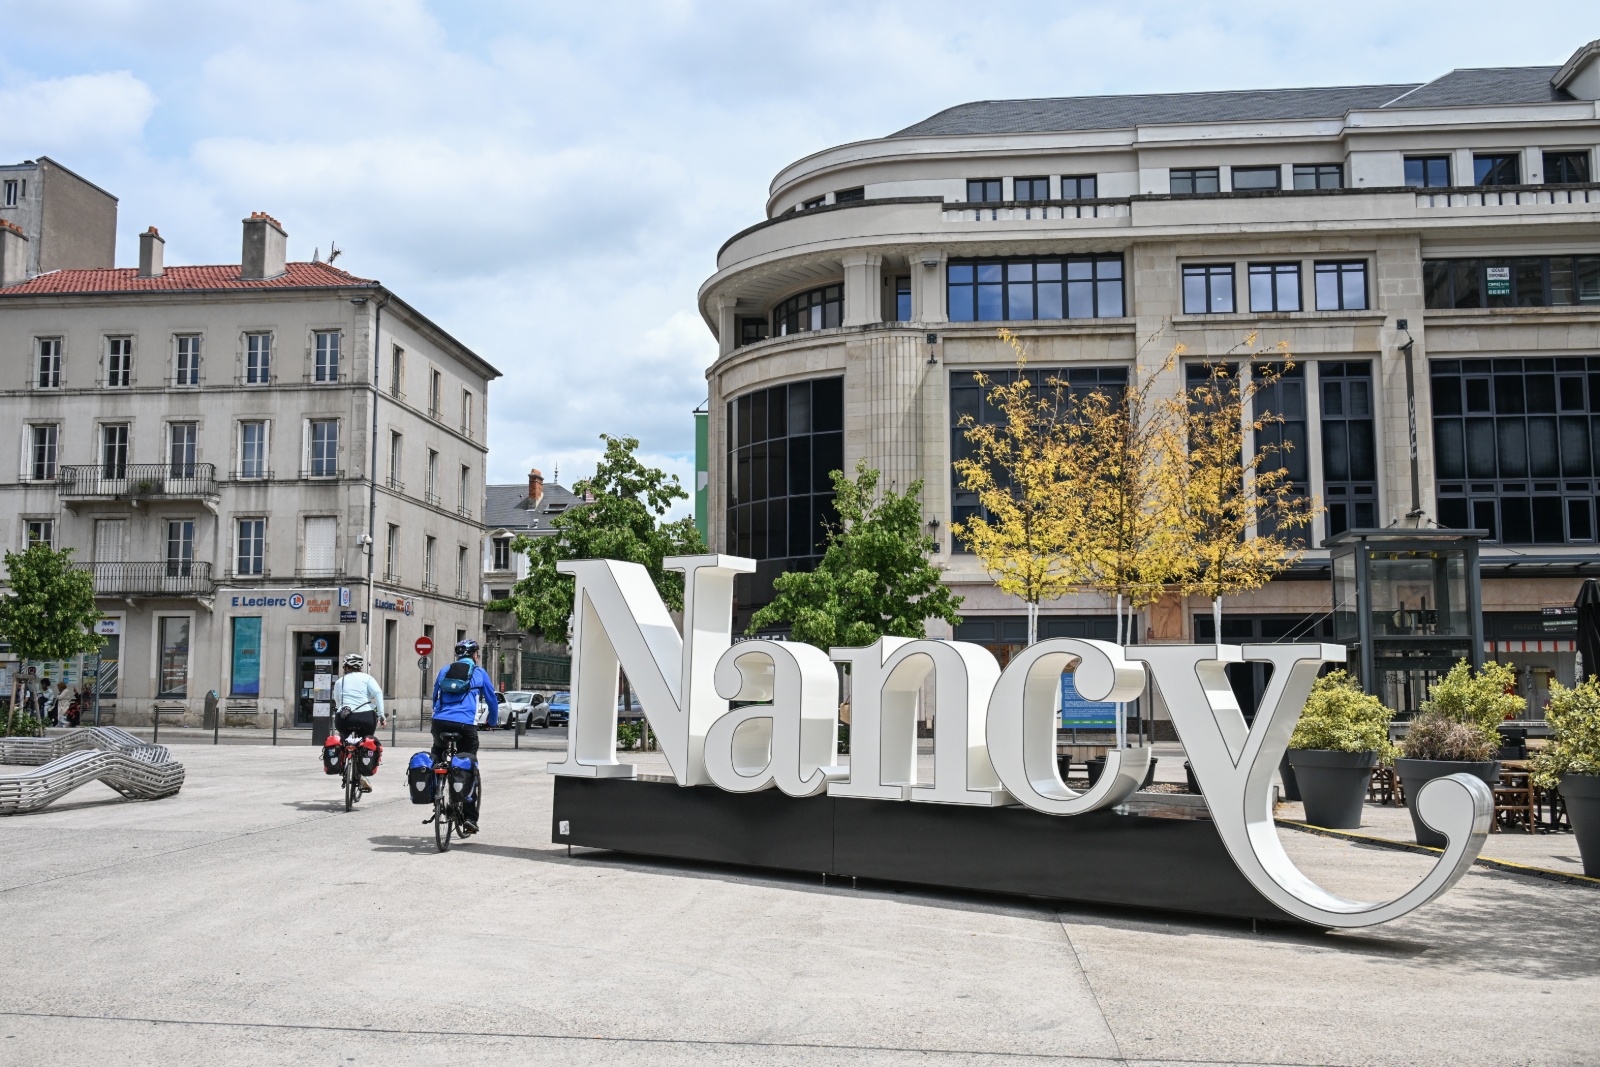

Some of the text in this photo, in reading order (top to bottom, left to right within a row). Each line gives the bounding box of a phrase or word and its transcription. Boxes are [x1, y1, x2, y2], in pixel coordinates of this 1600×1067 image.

[1408, 396, 1417, 461] fnac
[231, 596, 287, 607] E.Leclerc
[375, 598, 396, 611] E.Leclerc
[546, 553, 1496, 930] Nancy
